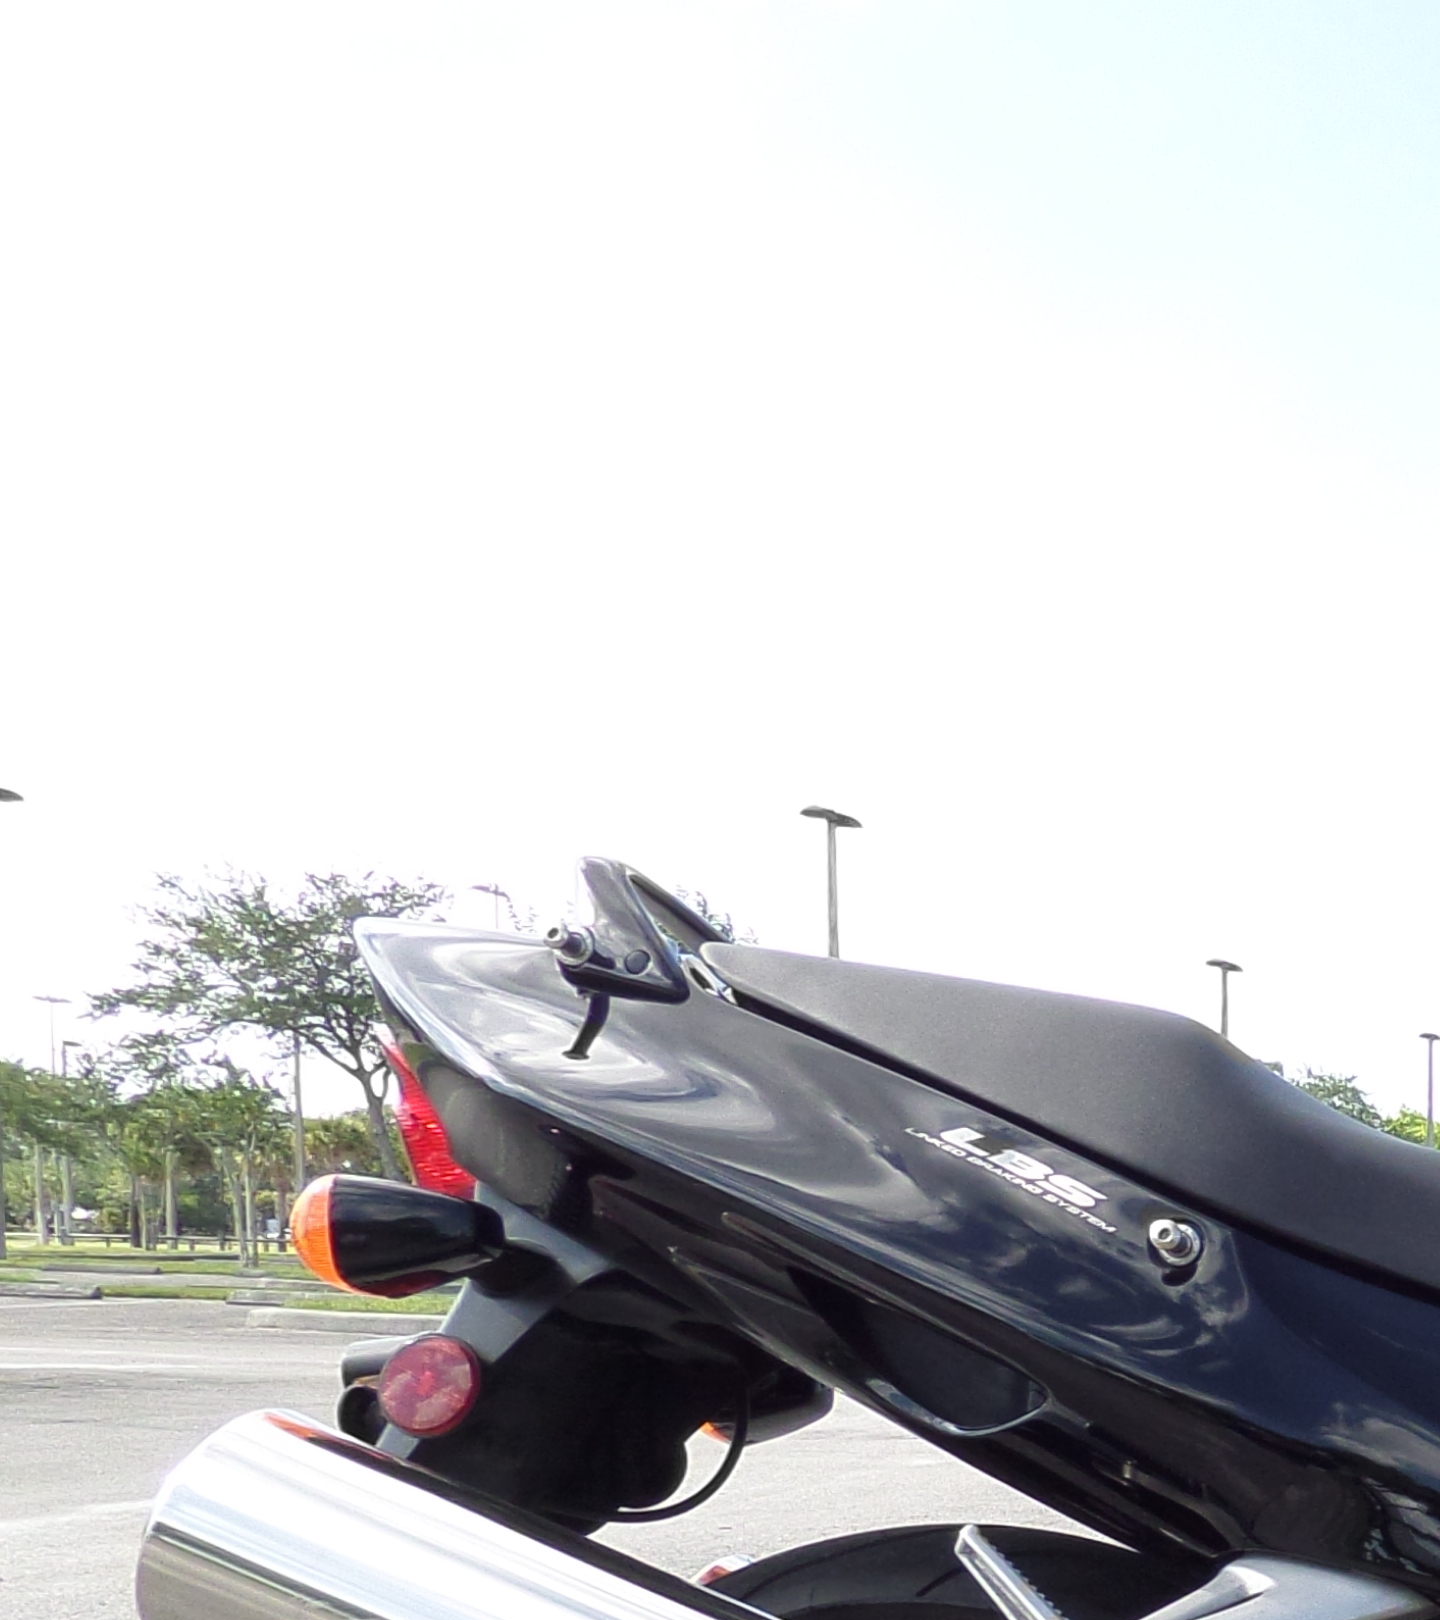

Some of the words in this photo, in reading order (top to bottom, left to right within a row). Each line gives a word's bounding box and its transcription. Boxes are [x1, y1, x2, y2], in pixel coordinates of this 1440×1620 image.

[940, 1127, 1108, 1208] LBS
[965, 1156, 1044, 1195] BRAKING
[1042, 1194, 1118, 1233] SYSTEM
